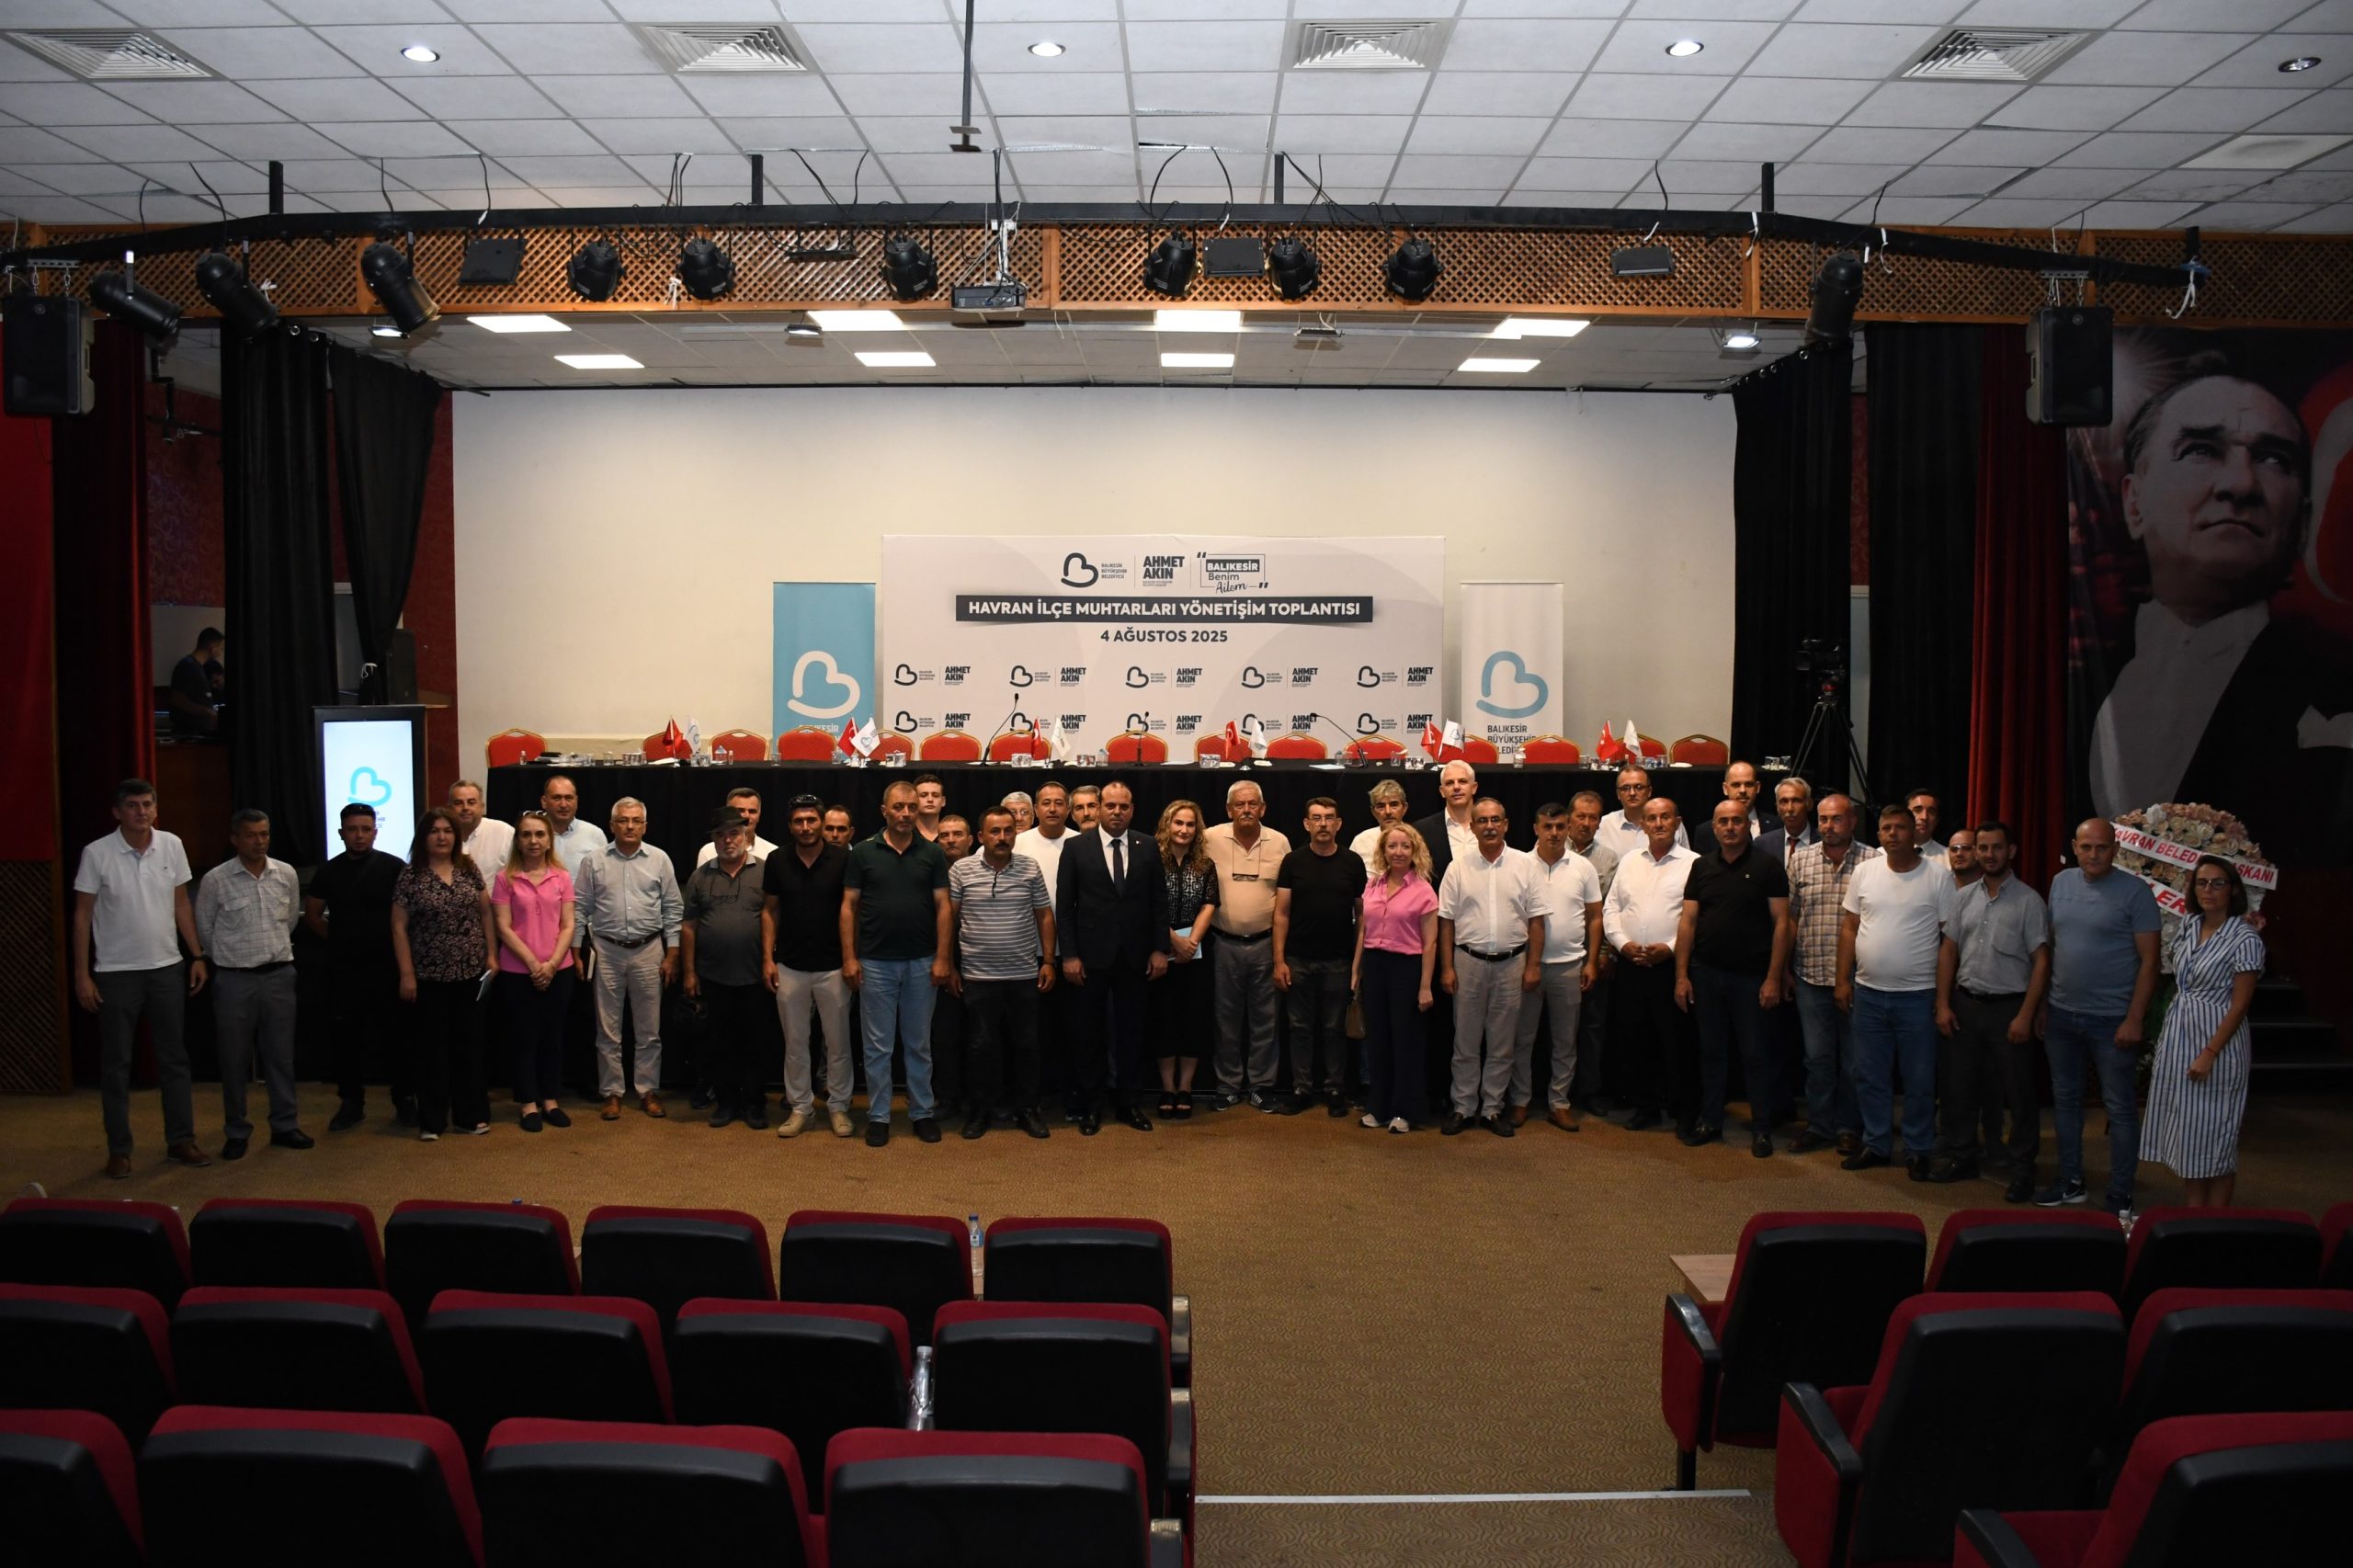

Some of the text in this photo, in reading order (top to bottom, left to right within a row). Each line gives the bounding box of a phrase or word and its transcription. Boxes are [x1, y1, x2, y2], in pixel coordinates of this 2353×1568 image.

[1142, 555, 1185, 568] AHMET
[1207, 561, 1258, 571] BALIKESİR
[1142, 568, 1174, 579] AKIN
[1208, 573, 1240, 581] Benim
[1215, 581, 1248, 594] Ailem
[969, 598, 1360, 619] HAVRAN İLÇE MUHTARLARI YÖNETİŞİM TOPLANTISI
[1100, 626, 1228, 642] 4 AĞUSTOS 2025
[1487, 722, 1528, 733] BALIKESİR
